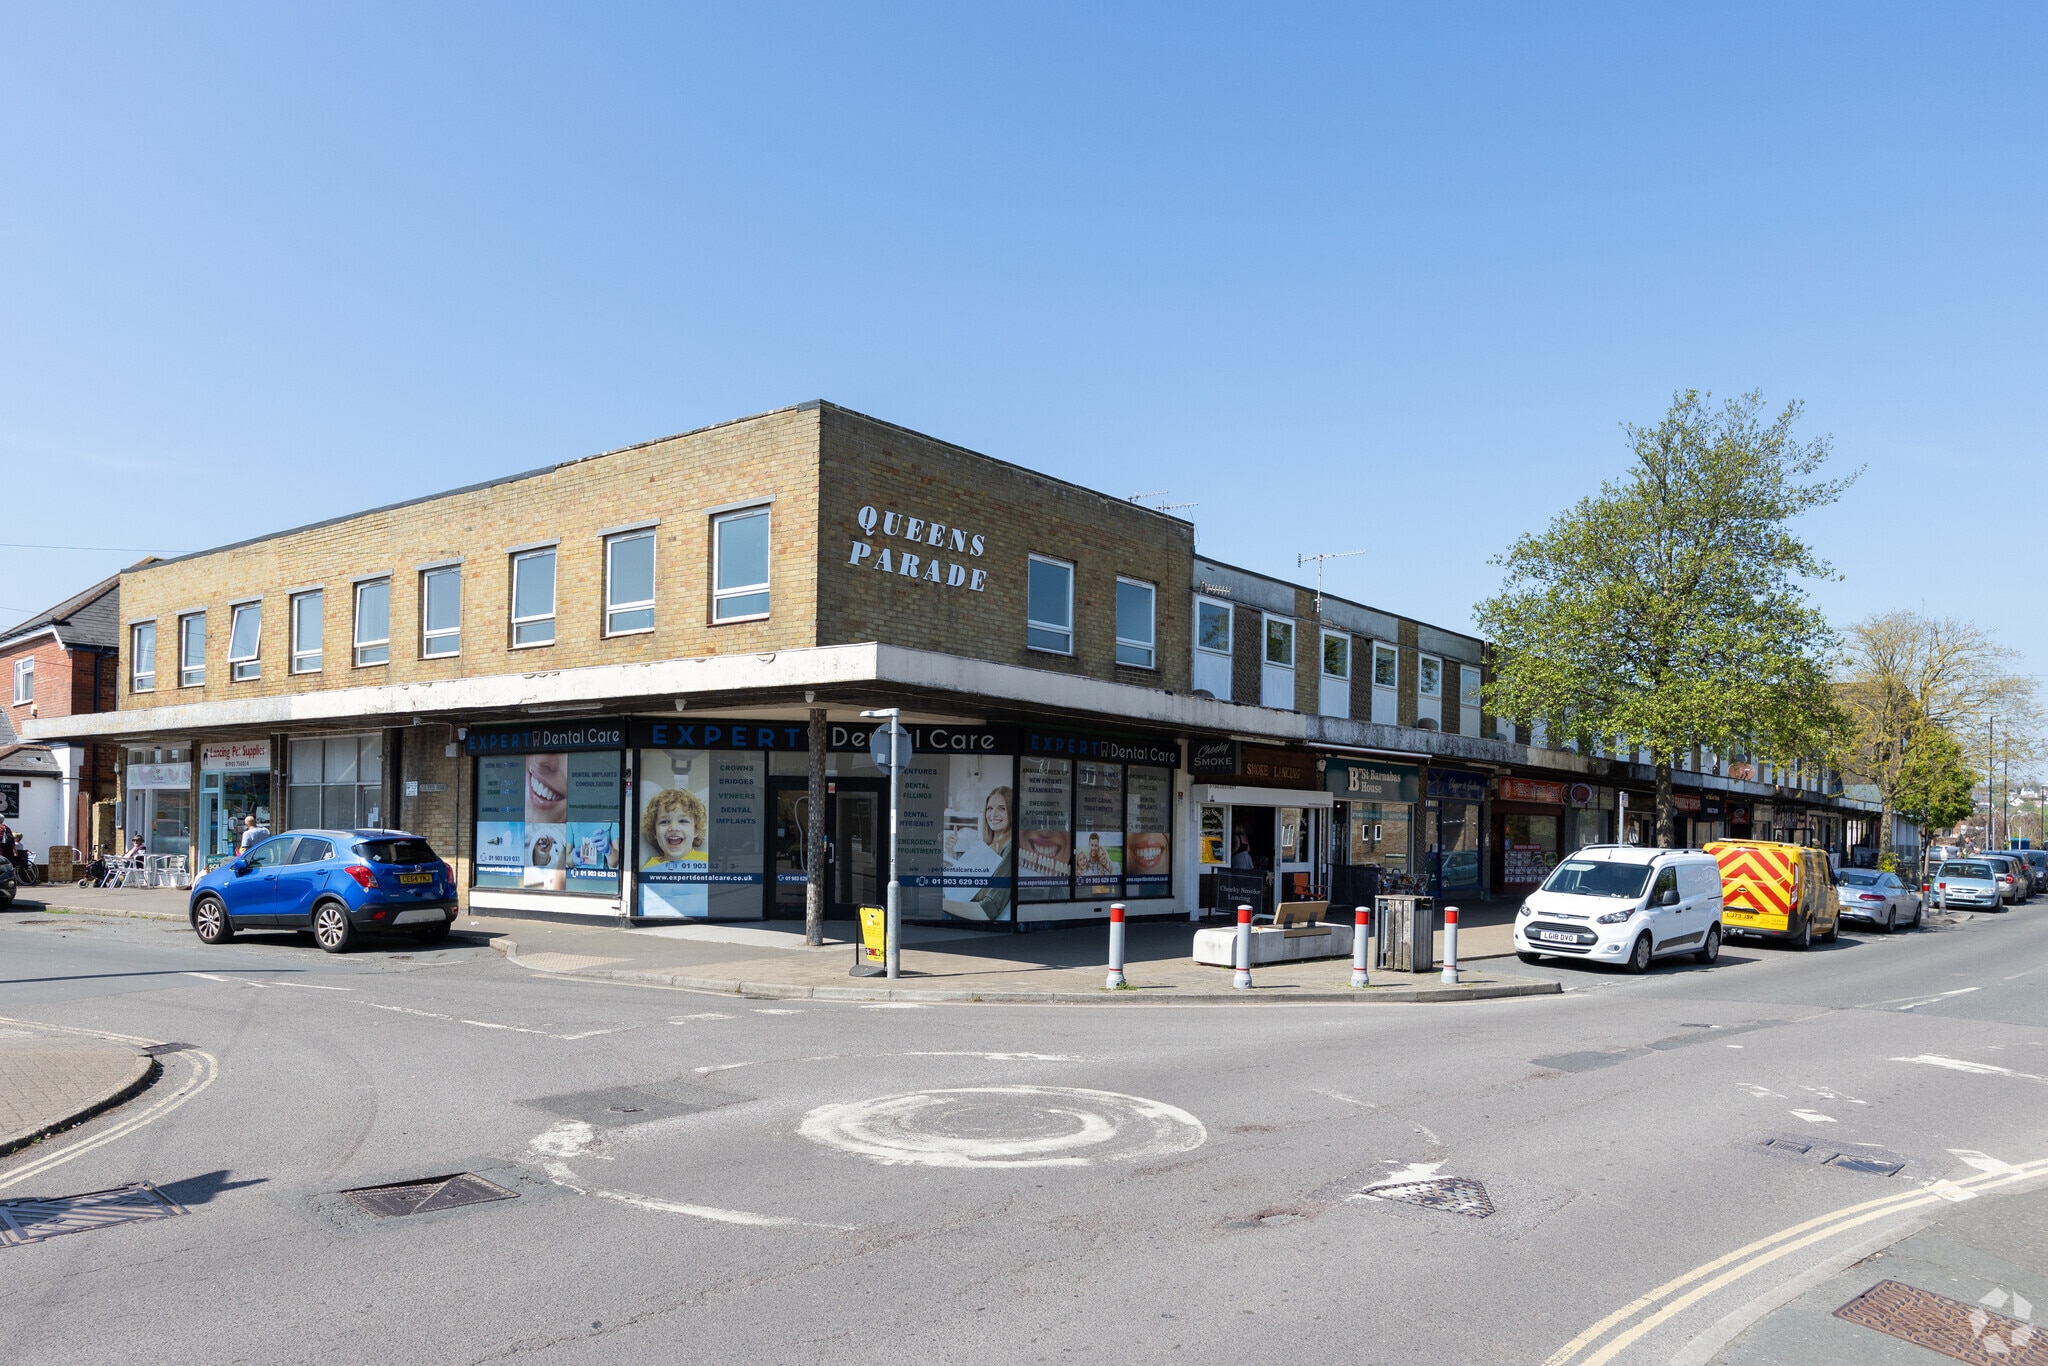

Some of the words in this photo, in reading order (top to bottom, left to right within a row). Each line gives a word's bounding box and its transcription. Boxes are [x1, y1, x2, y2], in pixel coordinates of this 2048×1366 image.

[857, 505, 985, 557] QUEENS
[848, 540, 987, 592] PARADE
[470, 732, 530, 749] EXPERT
[543, 729, 583, 746] Dental
[587, 728, 620, 743] Care
[653, 725, 800, 748] EXPERT
[930, 729, 995, 749] Care
[210, 746, 230, 760] Lancing
[243, 744, 265, 759] Supplies
[1031, 735, 1098, 755] EXPERT
[1111, 743, 1147, 760] Dental
[1150, 748, 1175, 762] Care
[1198, 743, 1229, 757] Cheeky
[1194, 757, 1232, 766] SMOKE
[1246, 763, 1269, 777] SMOKE
[1361, 769, 1370, 779] St
[1370, 770, 1401, 782] Barnabas
[1361, 782, 1382, 793] House
[649, 874, 753, 882] www.expertdentalcare.co.uk
[1220, 885, 1240, 894] Cheeky
[1228, 894, 1251, 902] Lancing
